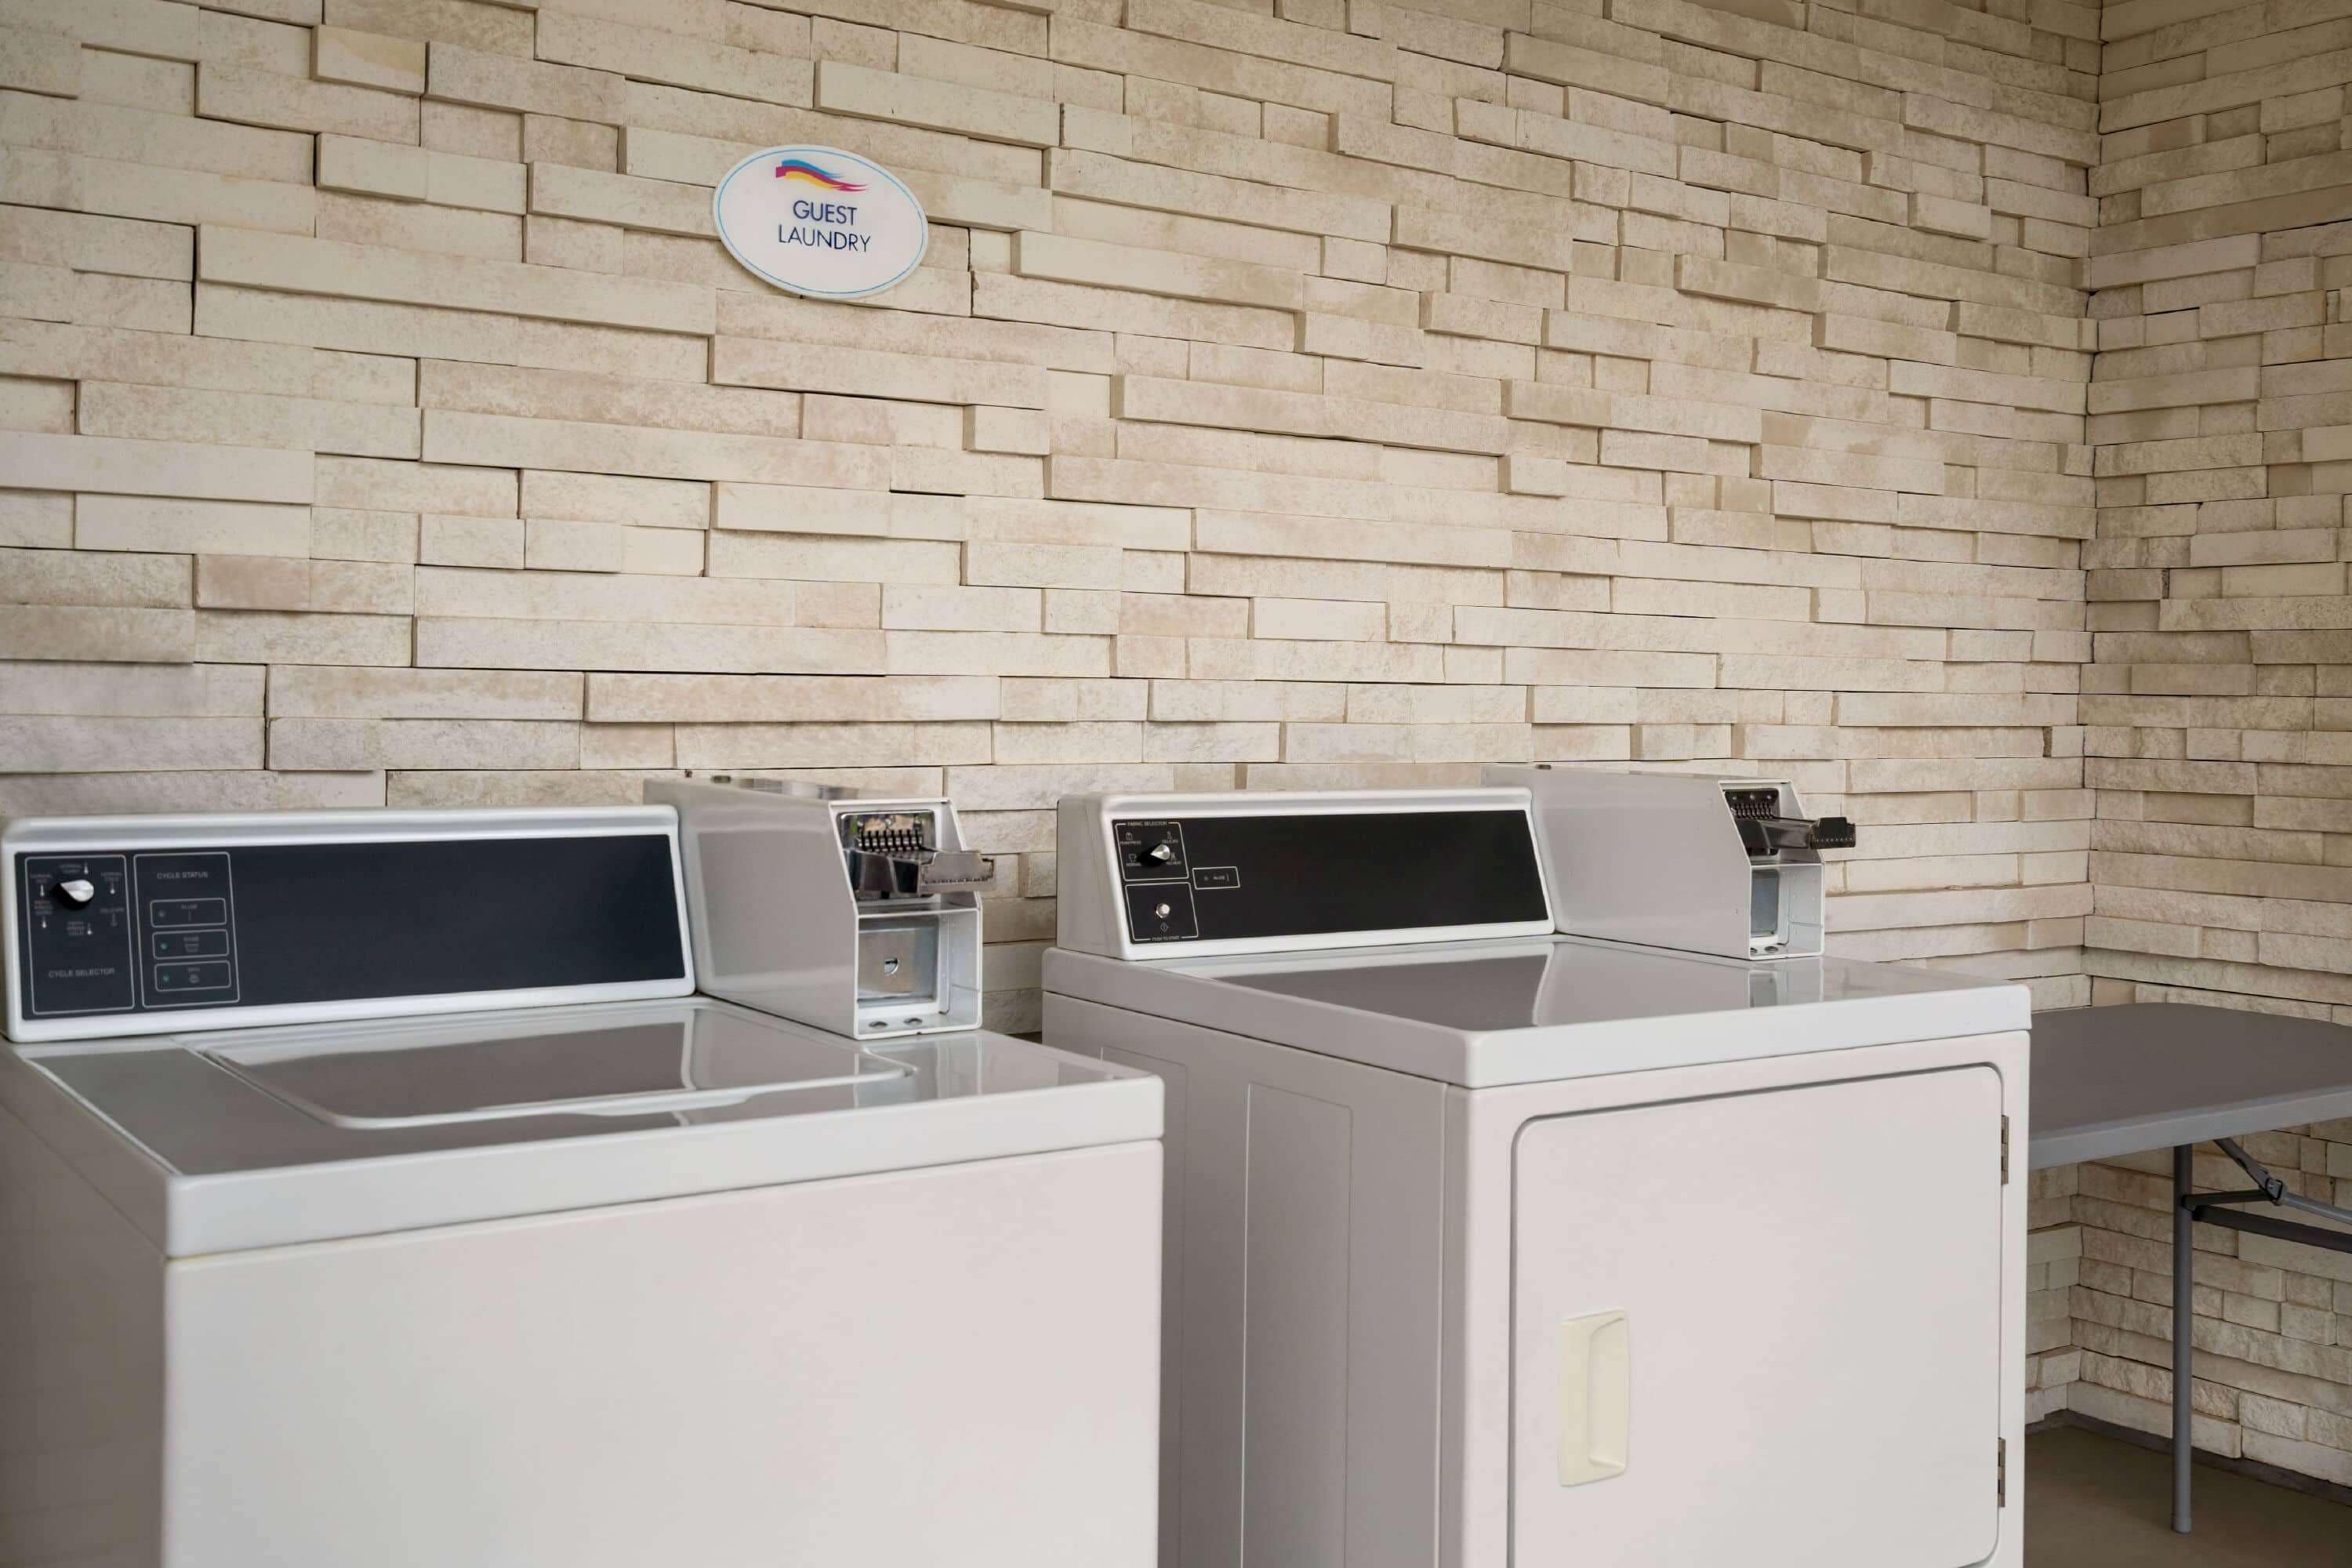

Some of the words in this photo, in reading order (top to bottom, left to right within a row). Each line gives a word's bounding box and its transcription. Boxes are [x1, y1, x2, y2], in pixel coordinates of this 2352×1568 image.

[793, 200, 857, 226] GUEST
[778, 224, 871, 252] LAUNDRY
[49, 969, 74, 978] CYCLE
[74, 967, 115, 977] SELECTOR
